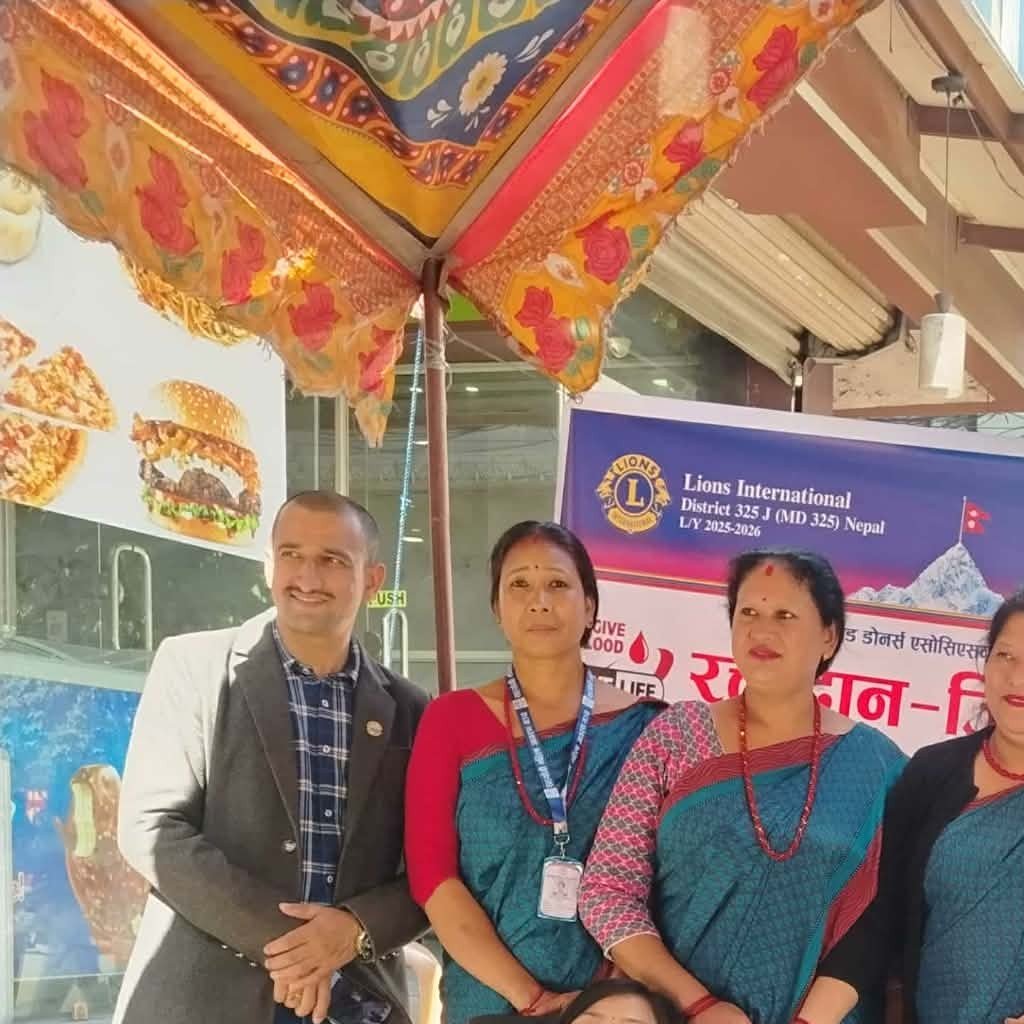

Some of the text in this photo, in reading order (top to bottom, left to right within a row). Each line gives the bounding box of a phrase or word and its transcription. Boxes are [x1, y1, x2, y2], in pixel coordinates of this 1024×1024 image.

[615, 456, 658, 476] LIONS
[625, 478, 645, 507] L
[683, 473, 852, 509] Lions International
[679, 515, 761, 537] L/Y 2025-2026
[681, 497, 885, 536] District 325 J (MD 325) Nepal
[369, 592, 405, 605] USH
[592, 637, 625, 654] OOD
[862, 626, 905, 650] डोनर्स
